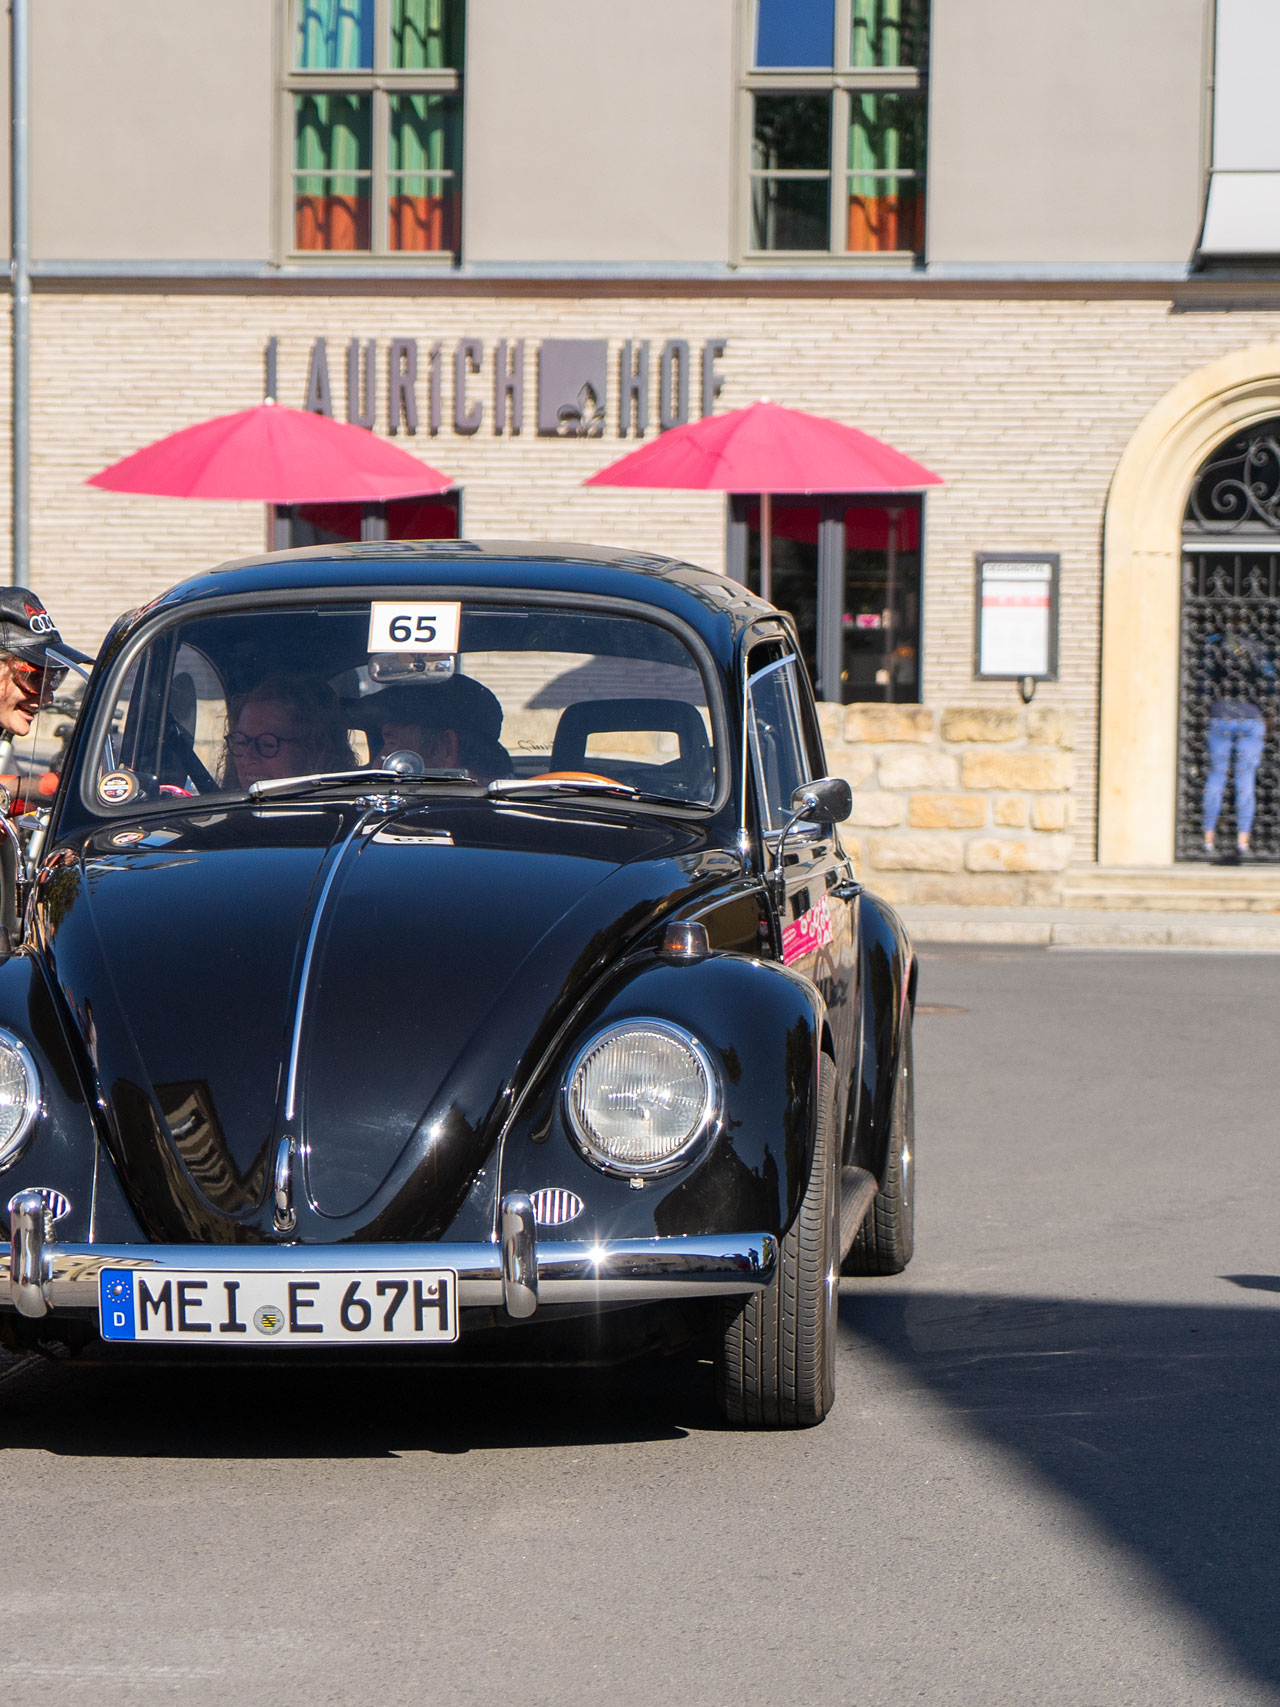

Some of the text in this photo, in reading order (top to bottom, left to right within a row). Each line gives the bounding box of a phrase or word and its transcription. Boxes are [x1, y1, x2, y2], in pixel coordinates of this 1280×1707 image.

[389, 615, 437, 643] 65
[113, 1311, 126, 1327] D
[138, 1279, 247, 1333] MEI
[288, 1281, 324, 1333] E
[340, 1279, 449, 1333] 67H
